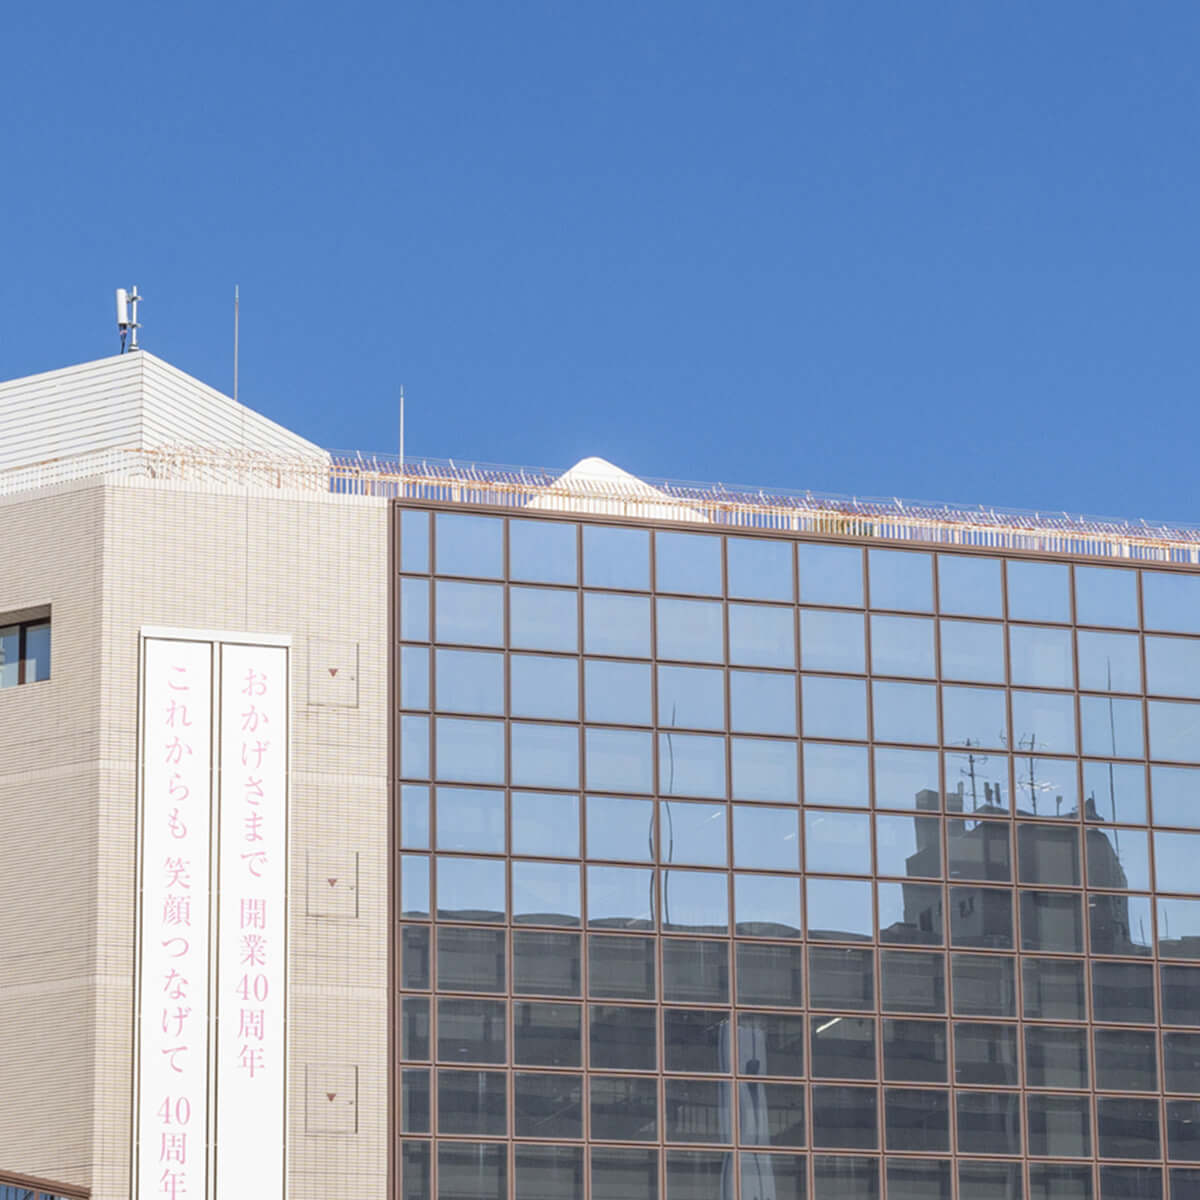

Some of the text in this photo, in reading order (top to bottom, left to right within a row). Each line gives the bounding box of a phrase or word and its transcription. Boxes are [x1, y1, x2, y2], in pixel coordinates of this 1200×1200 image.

[164, 664, 193, 839] これからも
[161, 856, 192, 1073] 笑顔つなげて
[235, 667, 270, 1079] おかげさまで 開業40周年
